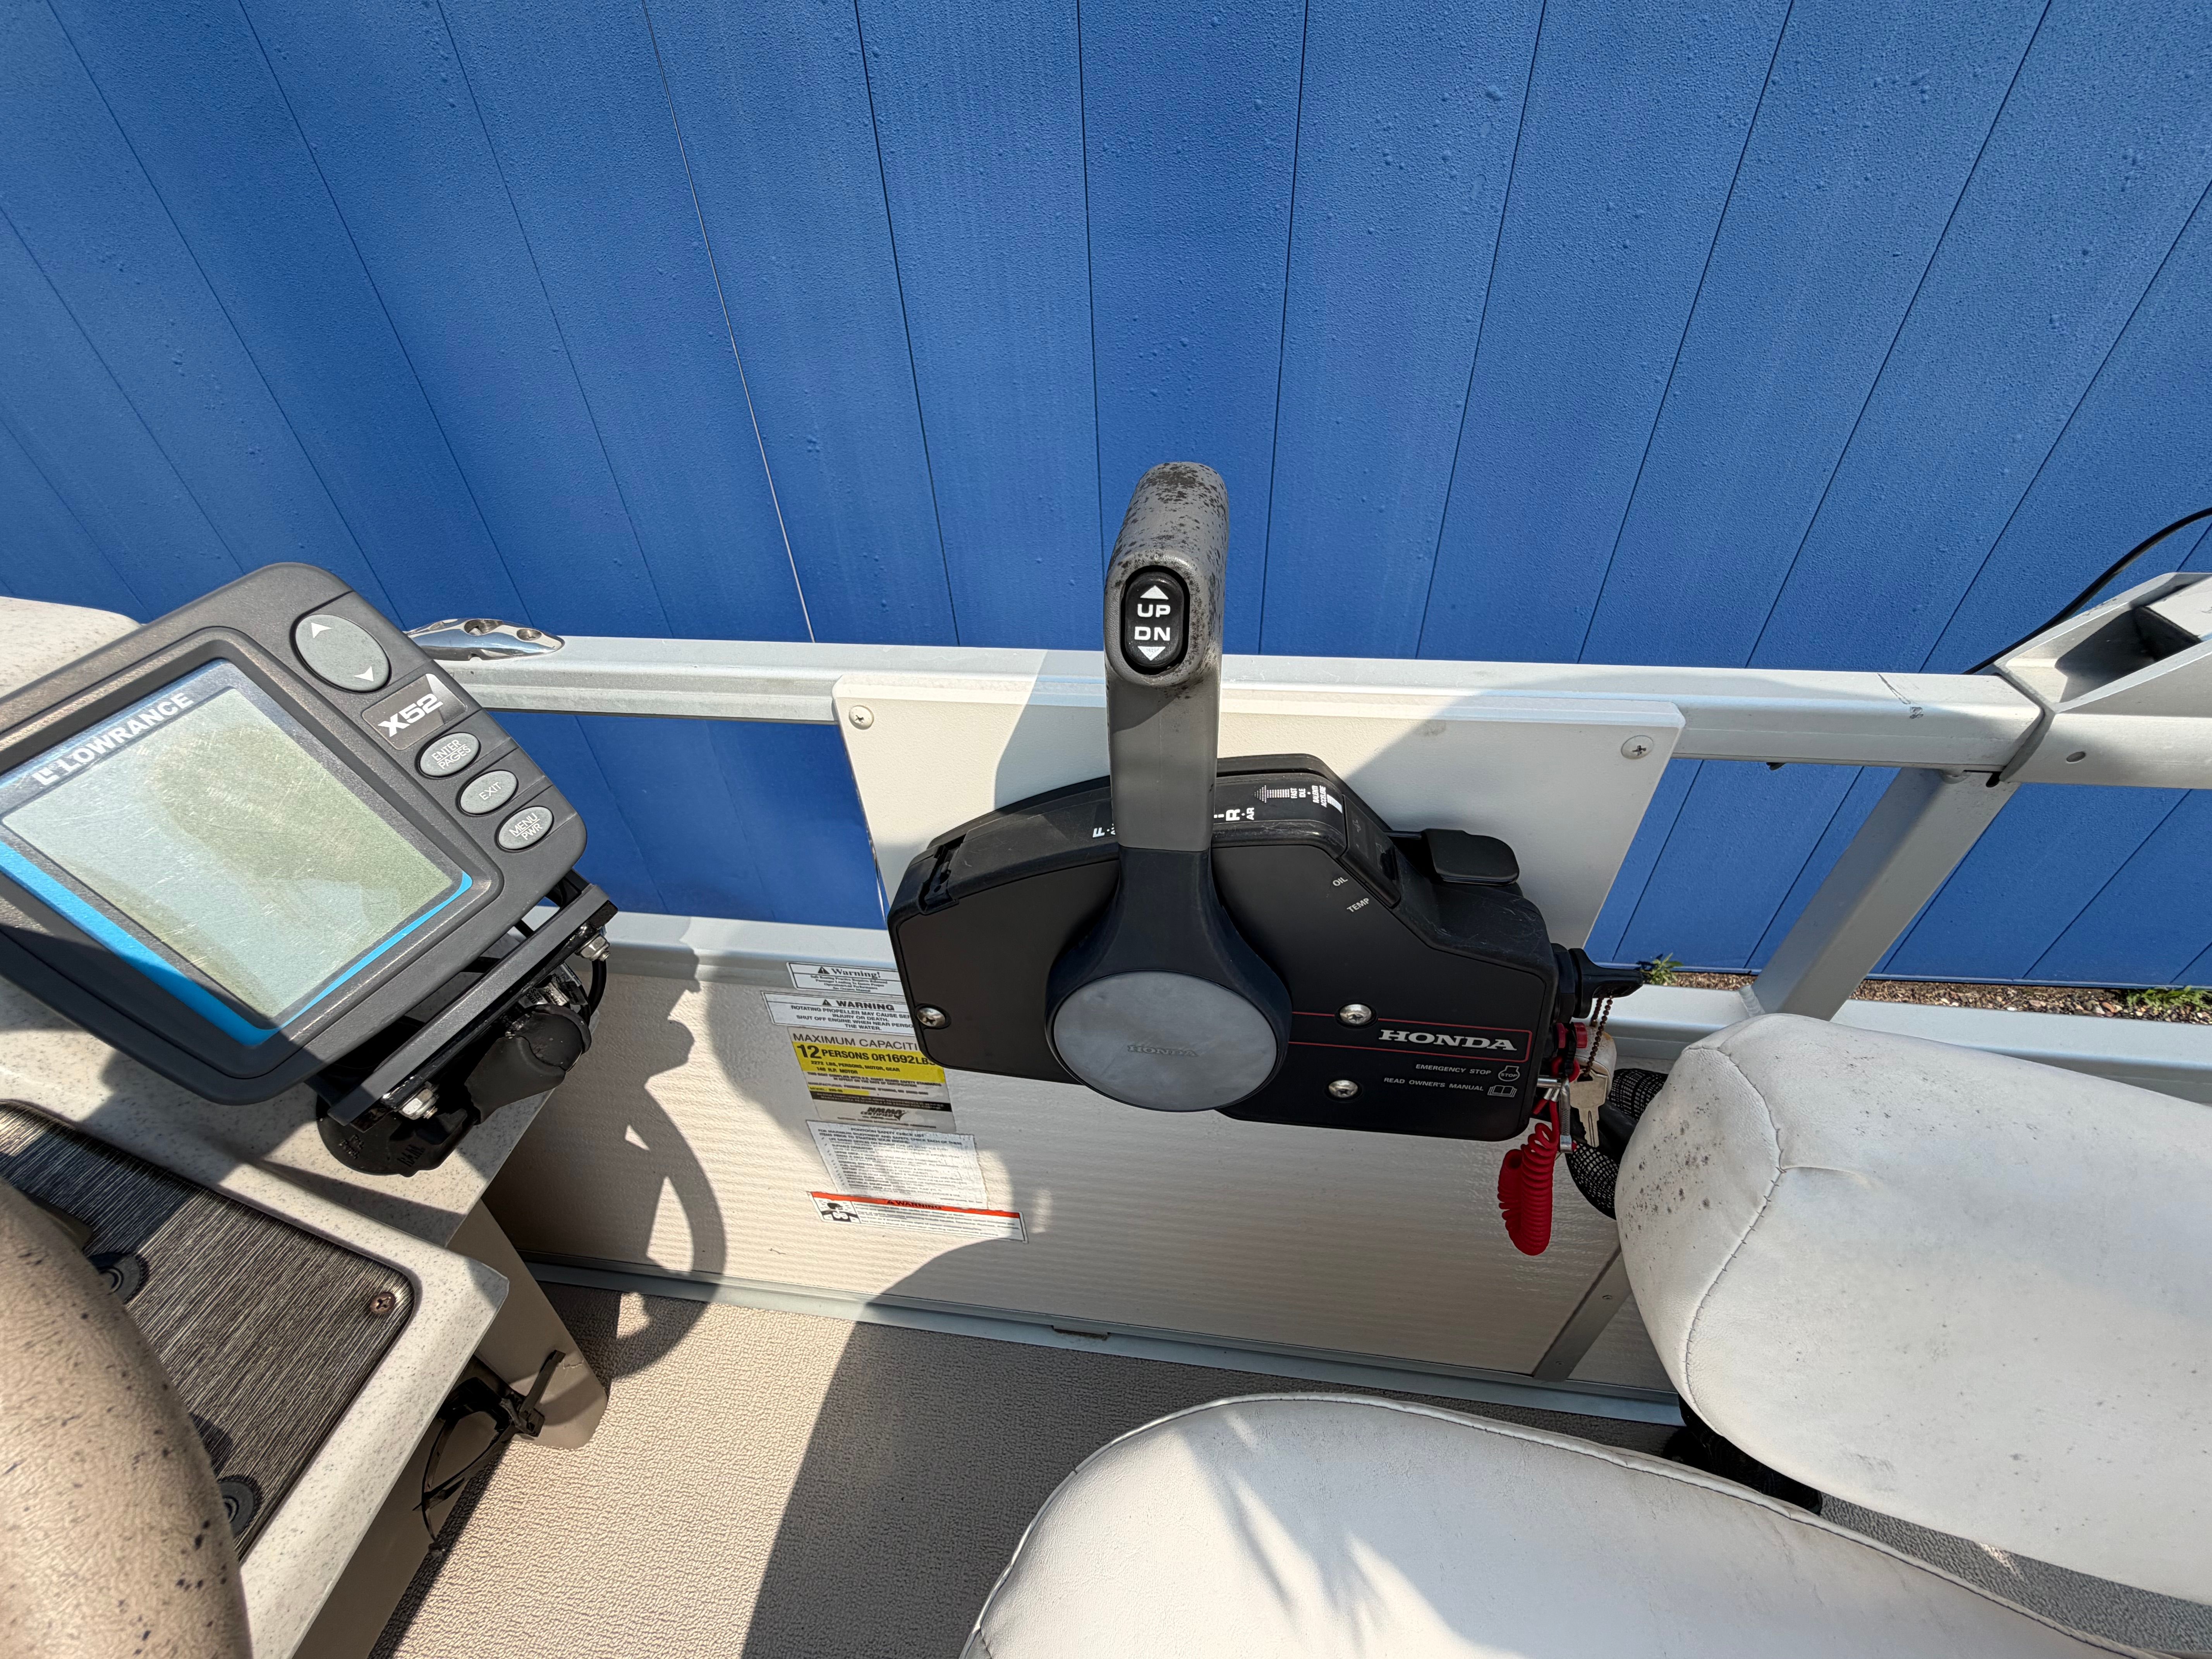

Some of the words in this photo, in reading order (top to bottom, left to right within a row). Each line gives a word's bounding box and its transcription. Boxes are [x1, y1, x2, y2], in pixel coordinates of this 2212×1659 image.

[1137, 604, 1170, 617] UP
[1135, 626, 1170, 641] DN
[378, 694, 443, 737] X52
[57, 692, 194, 772] LOWRANCE
[431, 739, 461, 762] ENTER
[438, 745, 471, 769] PAGES
[479, 782, 501, 800] EXIT
[1226, 809, 1240, 821] R
[1247, 807, 1254, 820] AR
[509, 812, 538, 836] MENU
[522, 823, 543, 840] PWR
[1092, 827, 1104, 838] F
[1333, 877, 1348, 886] OIL
[1346, 898, 1369, 912] TEMP
[831, 968, 881, 979] Warning!
[836, 1000, 895, 1011] WARNING
[793, 1033, 856, 1046] MAXIMUM
[1378, 1029, 1517, 1051] HONDA
[797, 1044, 822, 1059] 12
[821, 1049, 869, 1060] PERSONS
[1127, 1045, 1199, 1057] HONDA
[1416, 1064, 1467, 1073] EMERGENCY
[1409, 1080, 1445, 1088] OWNER'S
[1449, 1083, 1484, 1091] MANUAL
[895, 1200, 941, 1209] WARNING
